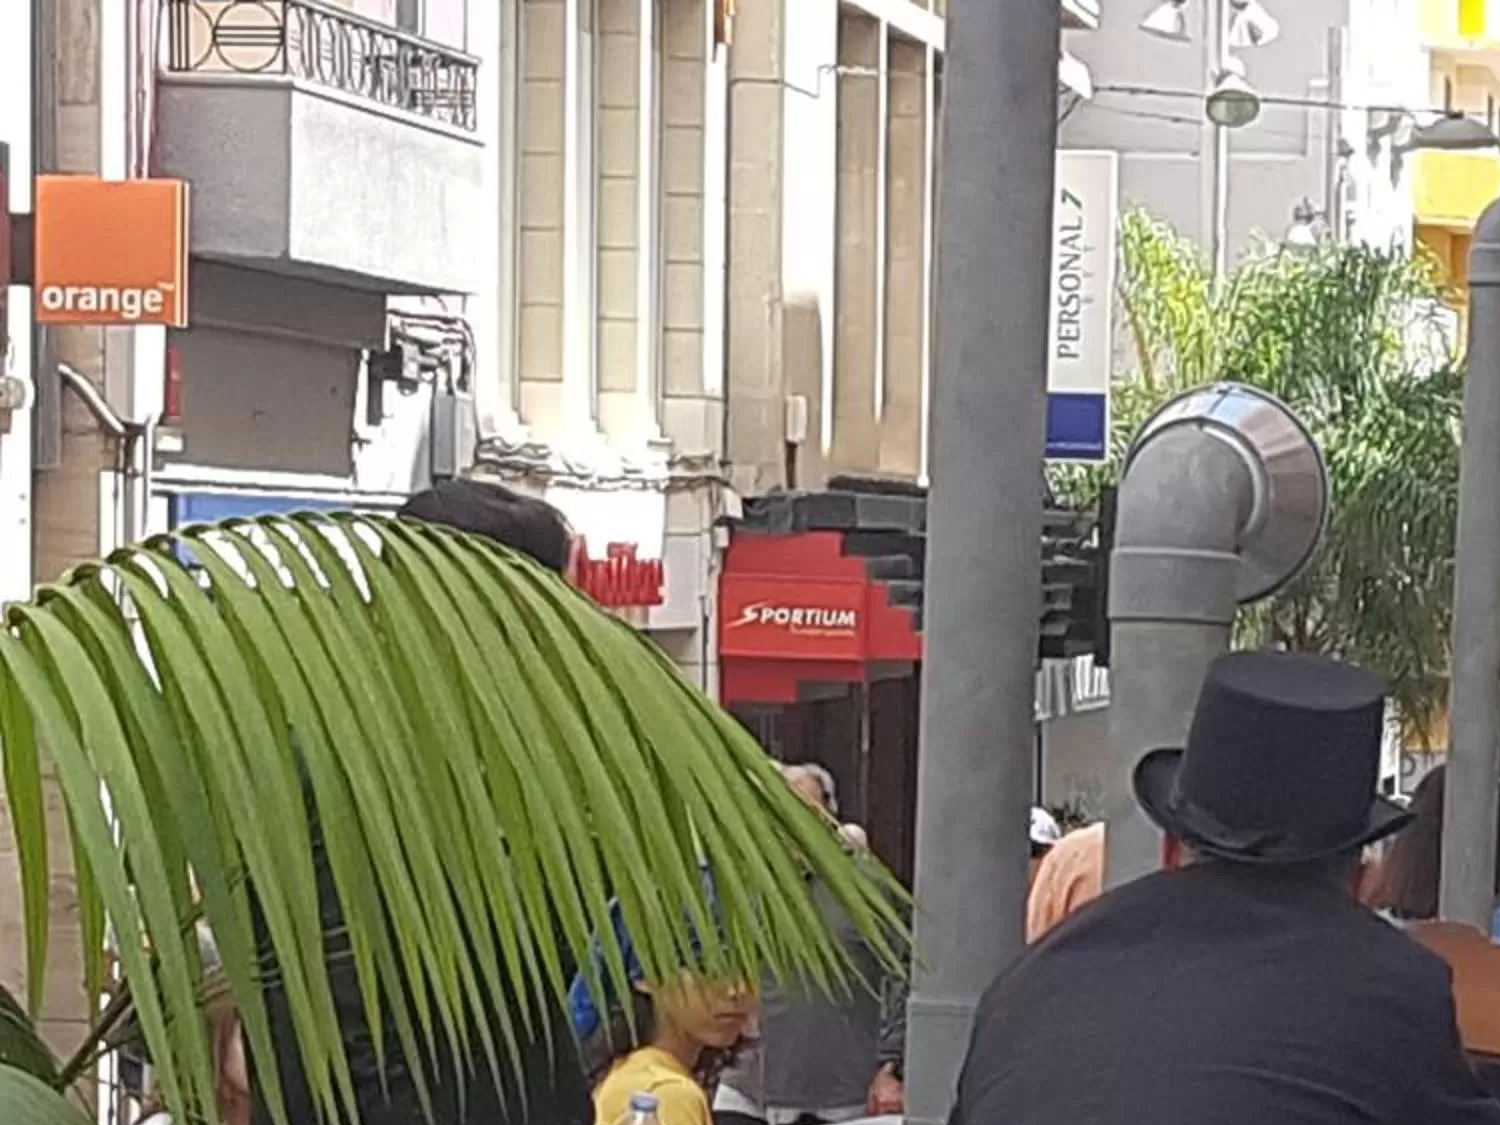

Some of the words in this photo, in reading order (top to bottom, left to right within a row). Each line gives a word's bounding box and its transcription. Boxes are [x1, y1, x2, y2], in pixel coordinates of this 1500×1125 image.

[42, 285, 164, 319] orange
[1056, 216, 1083, 360] PERSONAL
[725, 601, 857, 628] SPORTIUM
